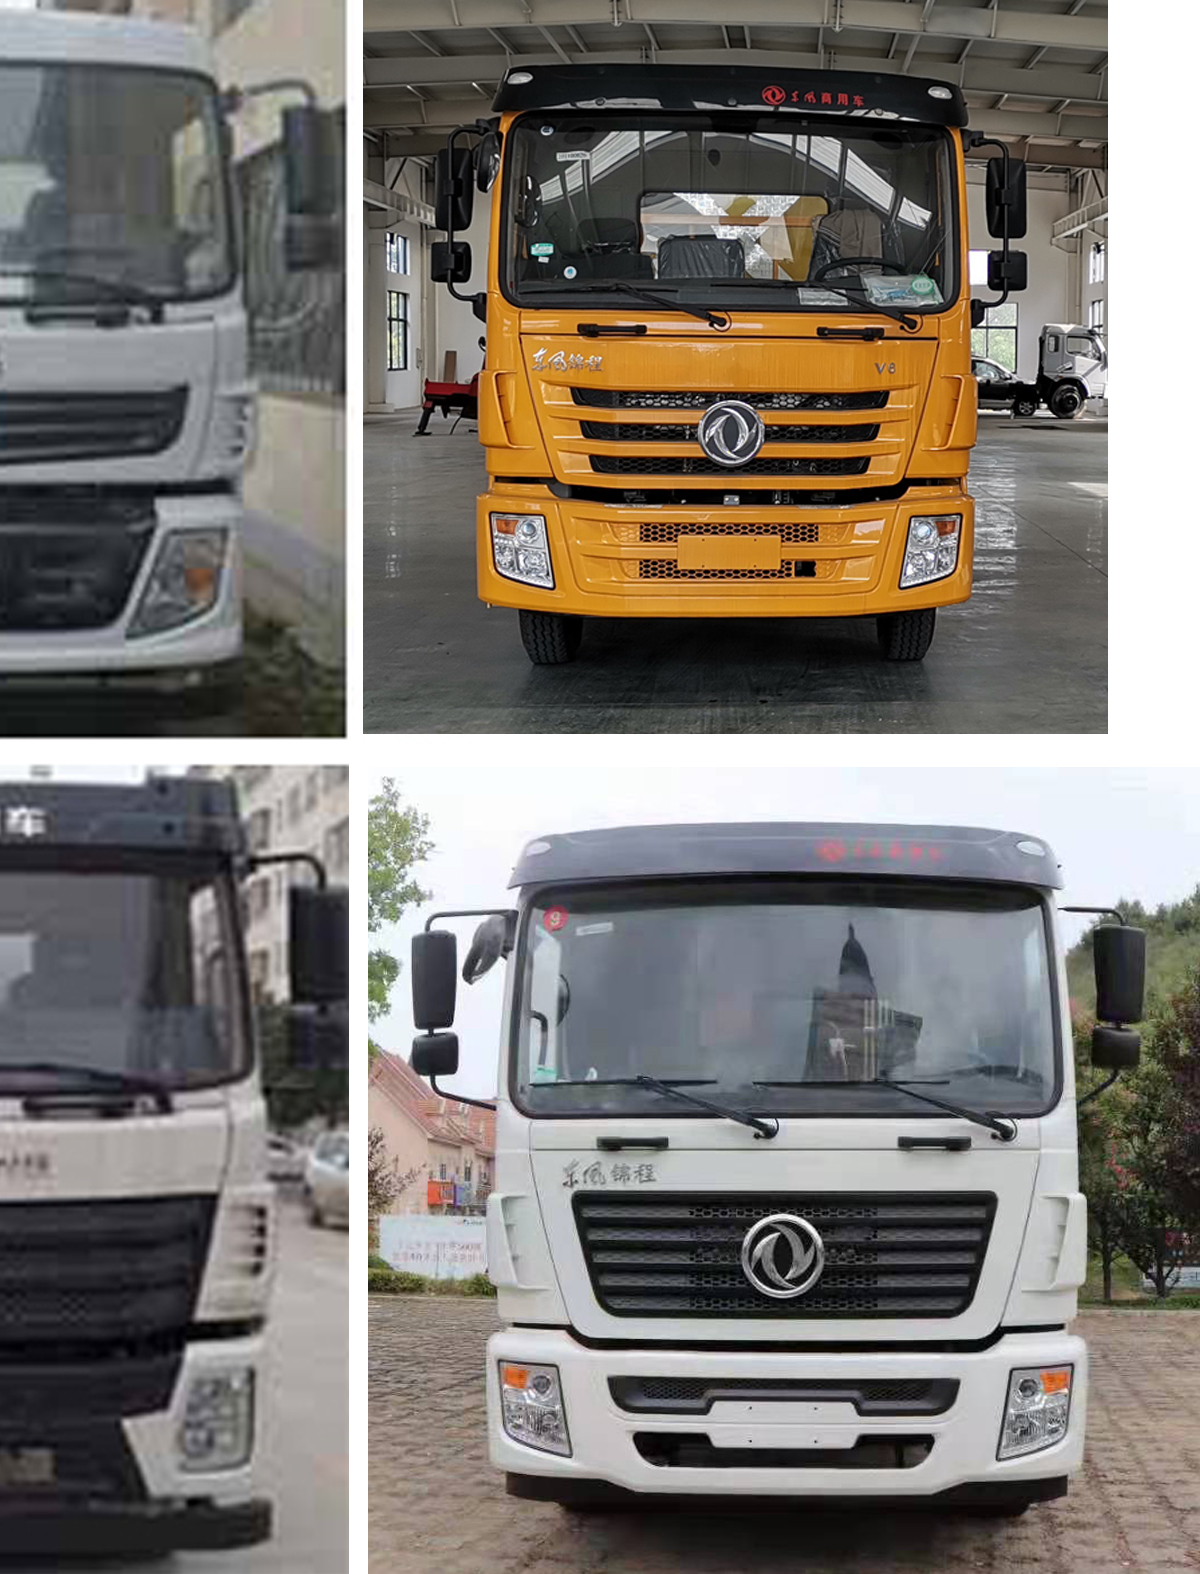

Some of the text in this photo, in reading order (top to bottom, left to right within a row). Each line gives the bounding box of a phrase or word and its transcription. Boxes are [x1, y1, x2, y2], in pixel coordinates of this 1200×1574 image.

[790, 90, 865, 108] 东风商用车
[531, 347, 604, 373] 东风锦程
[561, 1158, 658, 1188] 东风锦程
